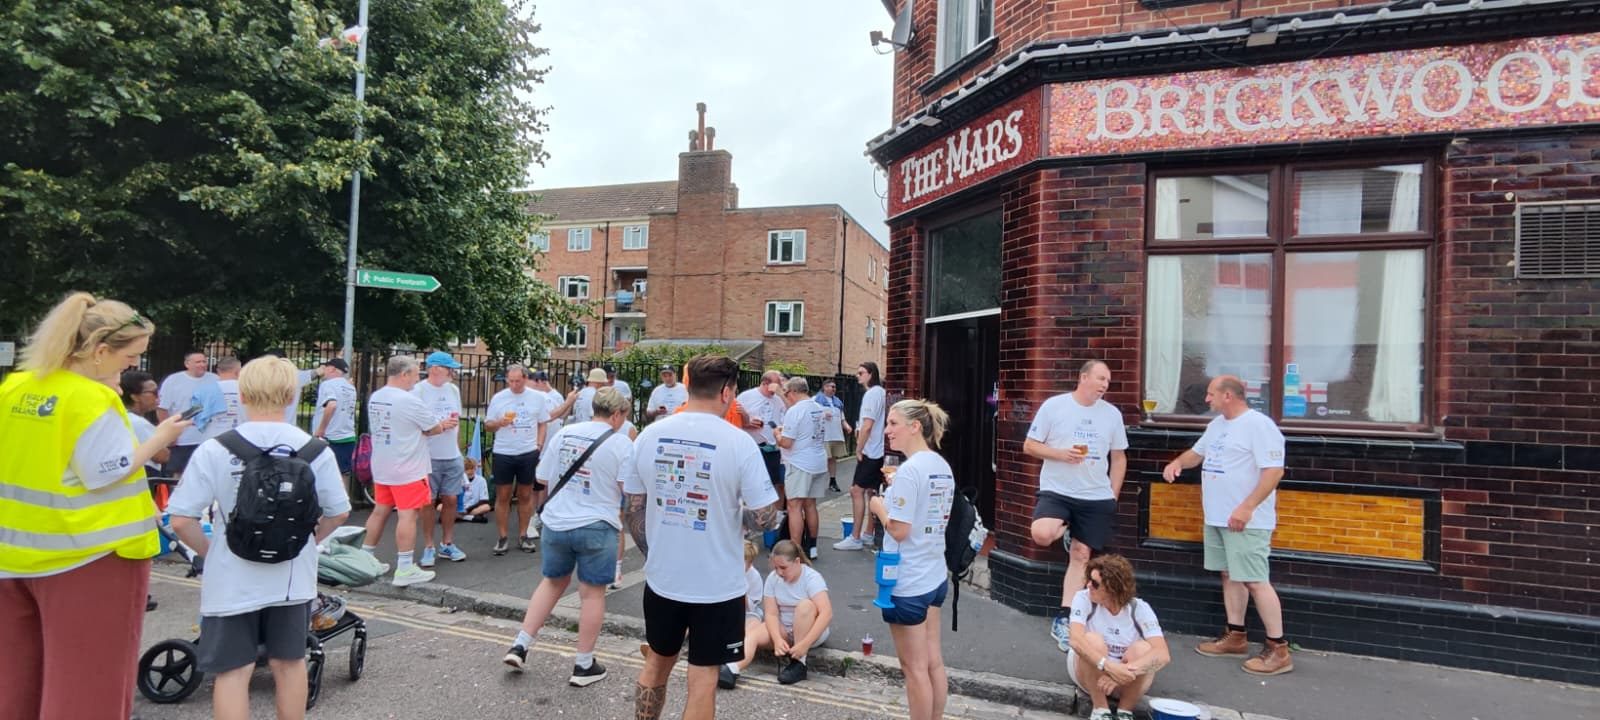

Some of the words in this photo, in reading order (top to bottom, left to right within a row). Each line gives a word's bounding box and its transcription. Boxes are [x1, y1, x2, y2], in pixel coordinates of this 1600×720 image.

[901, 148, 944, 203] THE
[945, 109, 1024, 185] MARS
[373, 275, 394, 284] Public
[396, 277, 427, 286] Footpath
